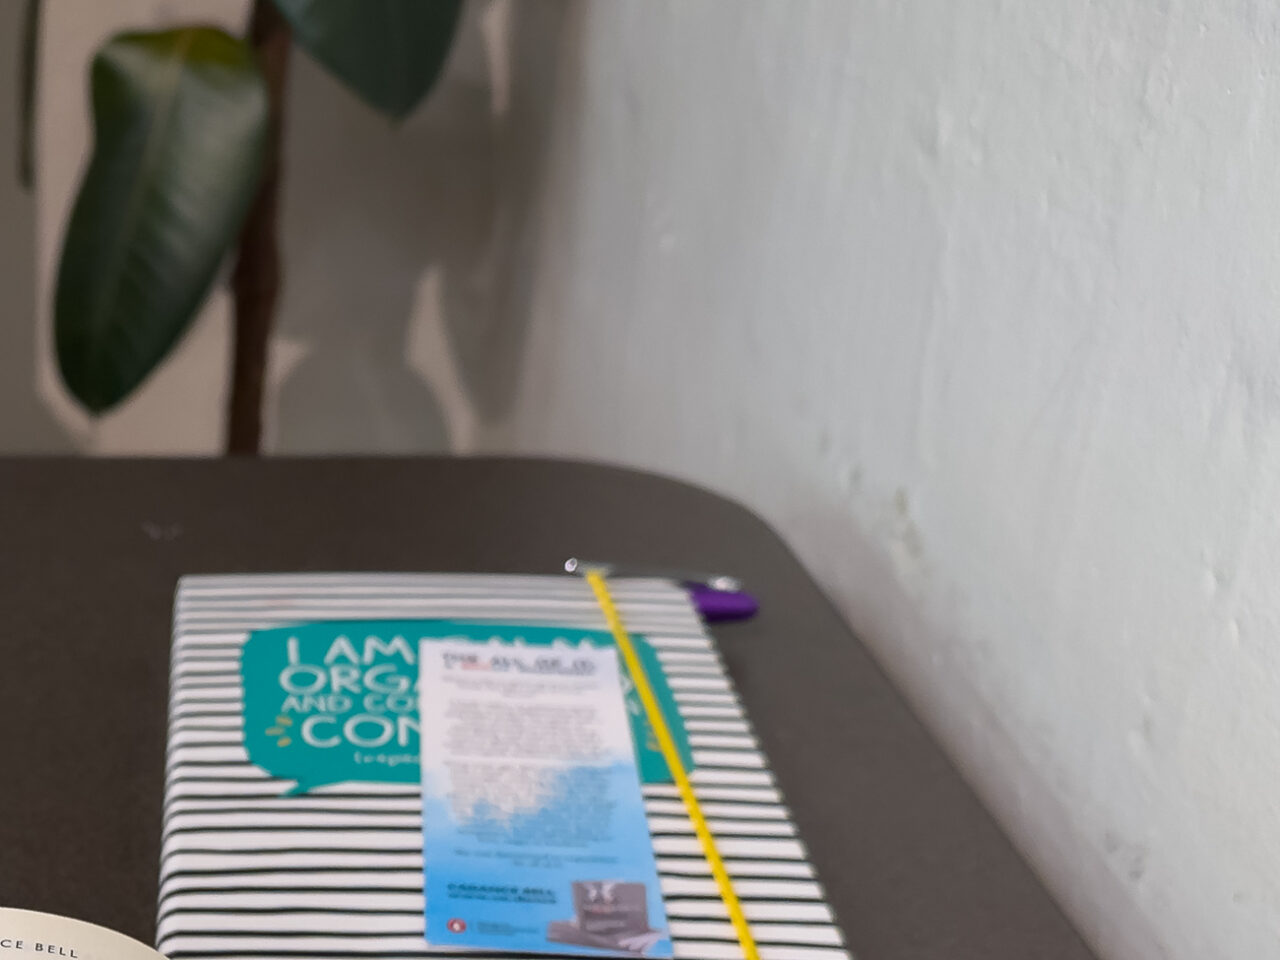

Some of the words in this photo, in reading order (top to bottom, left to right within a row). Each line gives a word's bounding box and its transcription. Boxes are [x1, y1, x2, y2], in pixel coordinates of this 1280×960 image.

[287, 636, 299, 665] I
[323, 635, 416, 665] AM
[281, 694, 352, 714] AND
[35, 943, 79, 959] BELL
